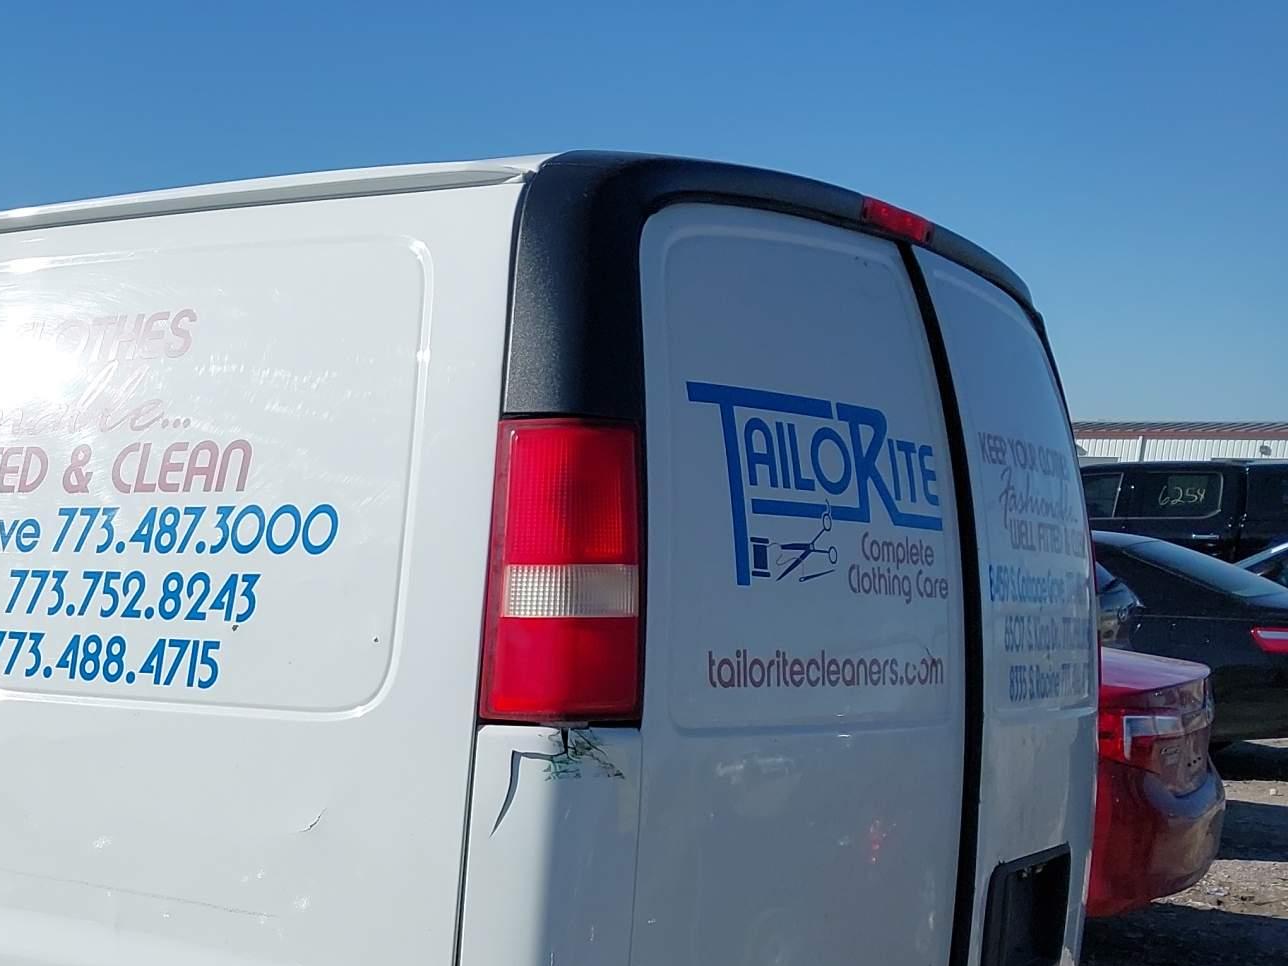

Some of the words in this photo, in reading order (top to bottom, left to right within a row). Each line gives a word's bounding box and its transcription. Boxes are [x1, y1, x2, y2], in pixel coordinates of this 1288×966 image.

[15, 308, 197, 362] OTHES
[62, 443, 93, 495] &
[112, 439, 253, 494] CLEAN
[1158, 485, 1206, 506] 6254
[52, 504, 339, 555] 773.487.3000
[862, 531, 934, 570] Complete
[5, 569, 262, 624] 773.752.8243
[848, 563, 912, 605] Clothing
[917, 569, 948, 599] Care
[708, 649, 945, 689] tailoritecleaners.com
